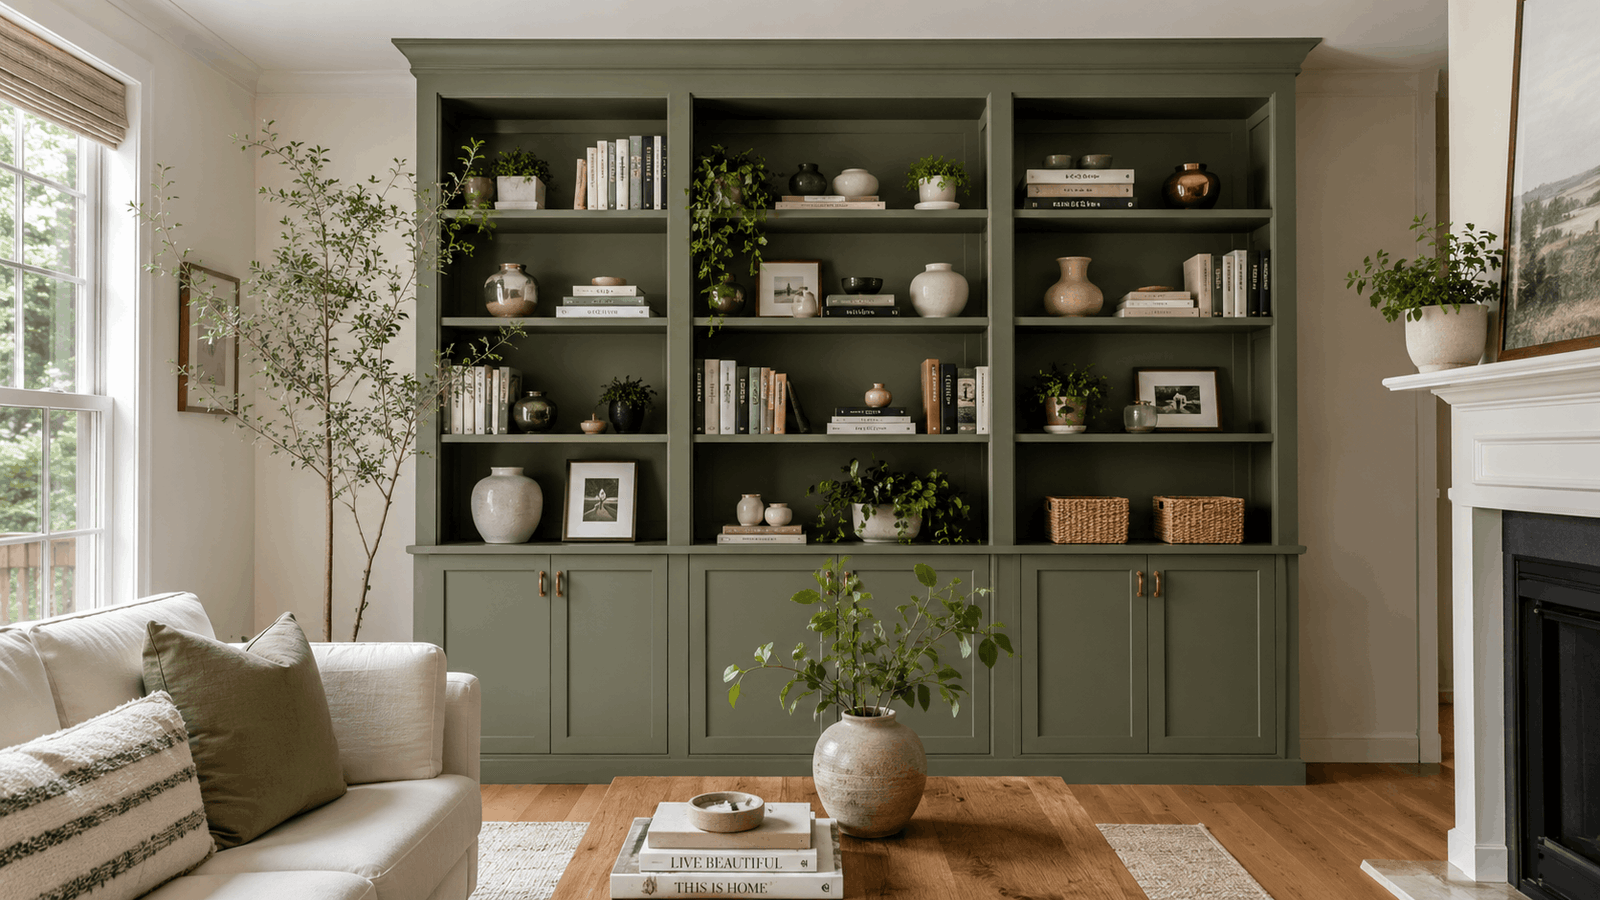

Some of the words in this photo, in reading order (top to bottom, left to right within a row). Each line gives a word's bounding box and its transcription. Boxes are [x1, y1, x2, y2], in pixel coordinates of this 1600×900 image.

[670, 856, 702, 869] LIVE
[706, 856, 783, 869] BEAUTIFUL
[674, 882, 707, 894] THIS
[711, 882, 724, 894] IS
[727, 882, 768, 894] HOME
